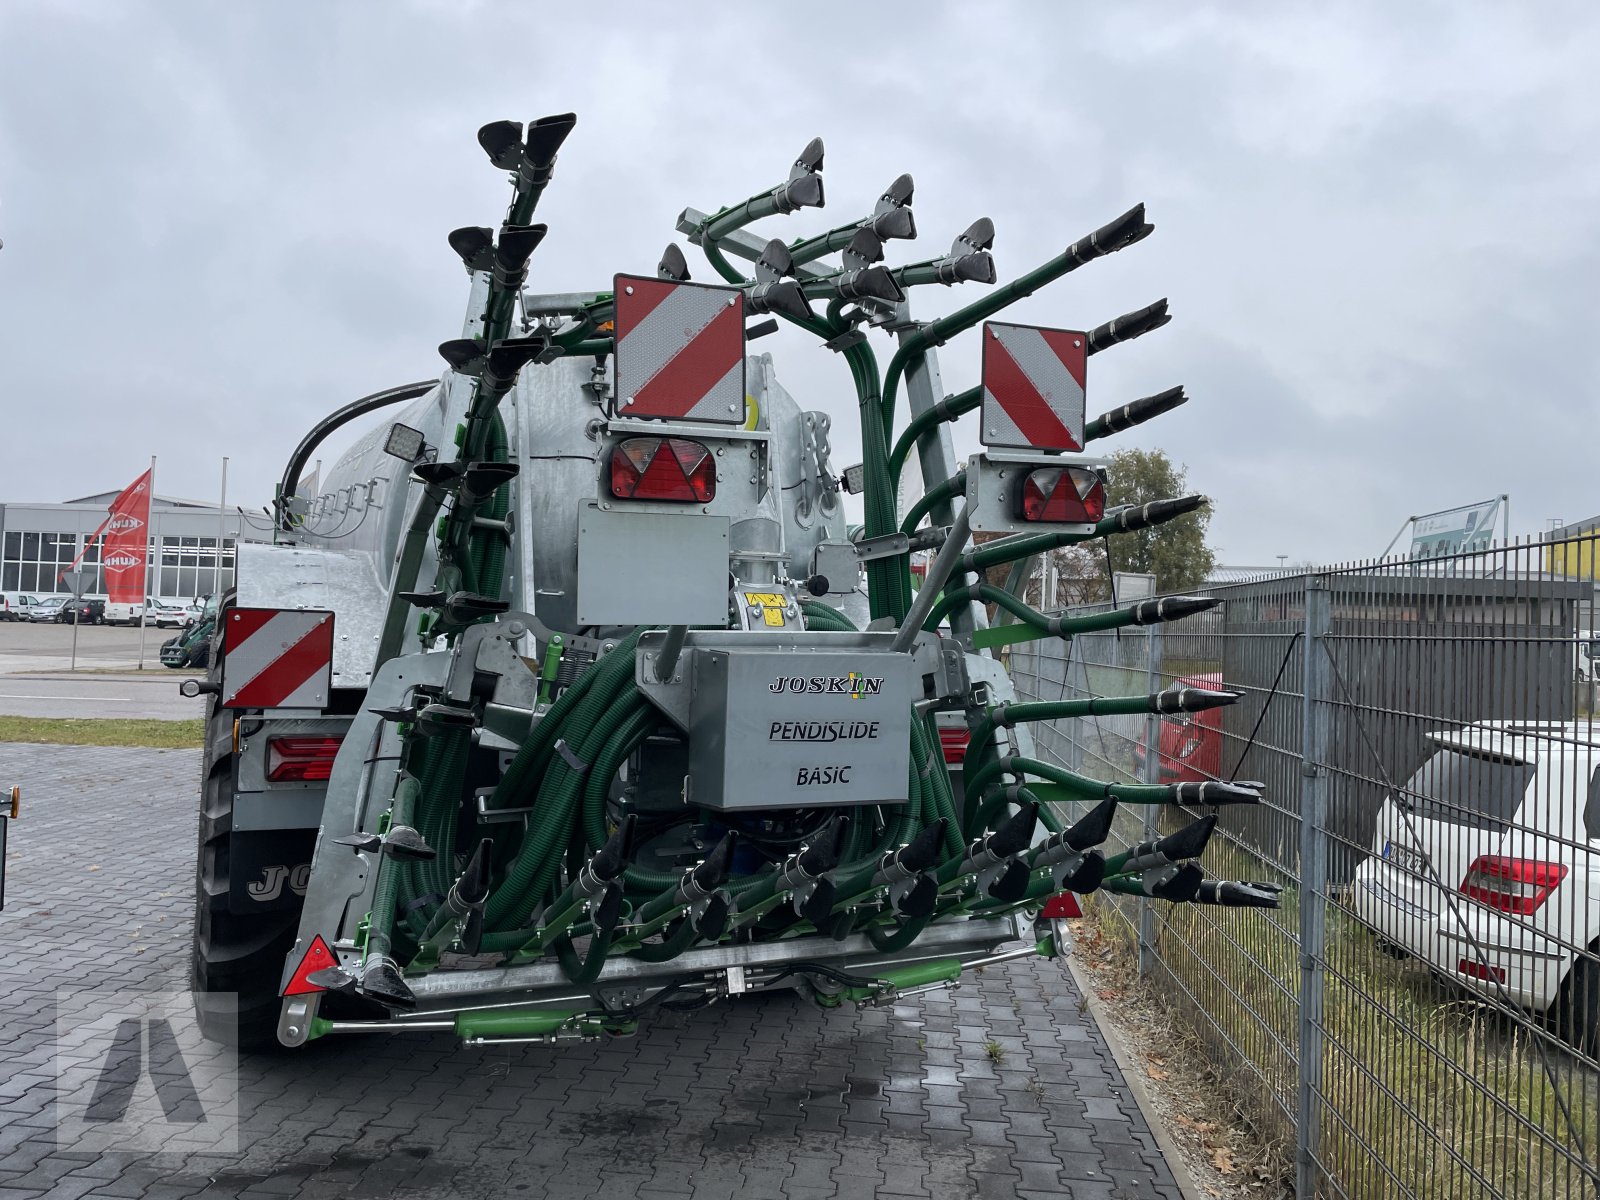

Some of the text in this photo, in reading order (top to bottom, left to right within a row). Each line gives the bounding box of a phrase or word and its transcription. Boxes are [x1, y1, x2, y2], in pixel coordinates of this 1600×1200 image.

[768, 675, 885, 695] JOSKIN
[768, 721, 880, 742] PENDISLIDE
[796, 765, 852, 786] BASIC
